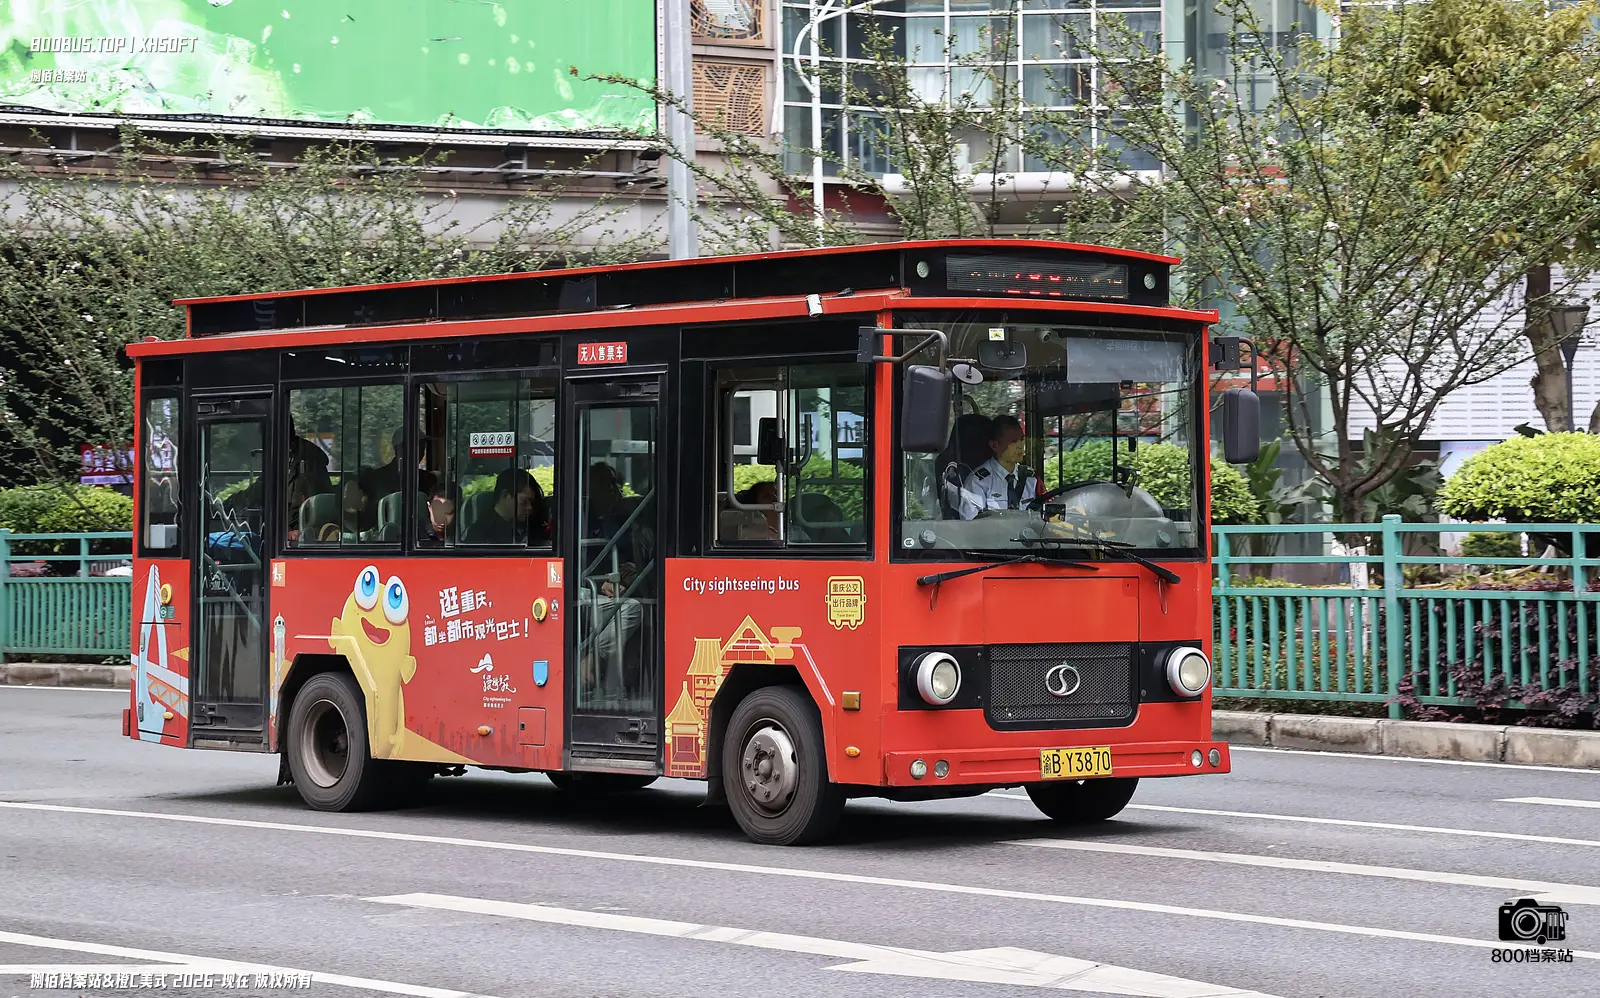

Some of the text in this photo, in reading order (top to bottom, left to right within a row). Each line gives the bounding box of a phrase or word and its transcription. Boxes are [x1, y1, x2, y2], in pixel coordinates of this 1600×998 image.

[580, 344, 625, 361] 无人售票车
[683, 575, 800, 595] City sightseeing bus
[832, 583, 859, 593] 重庆公交
[832, 598, 859, 608] 出行品牌
